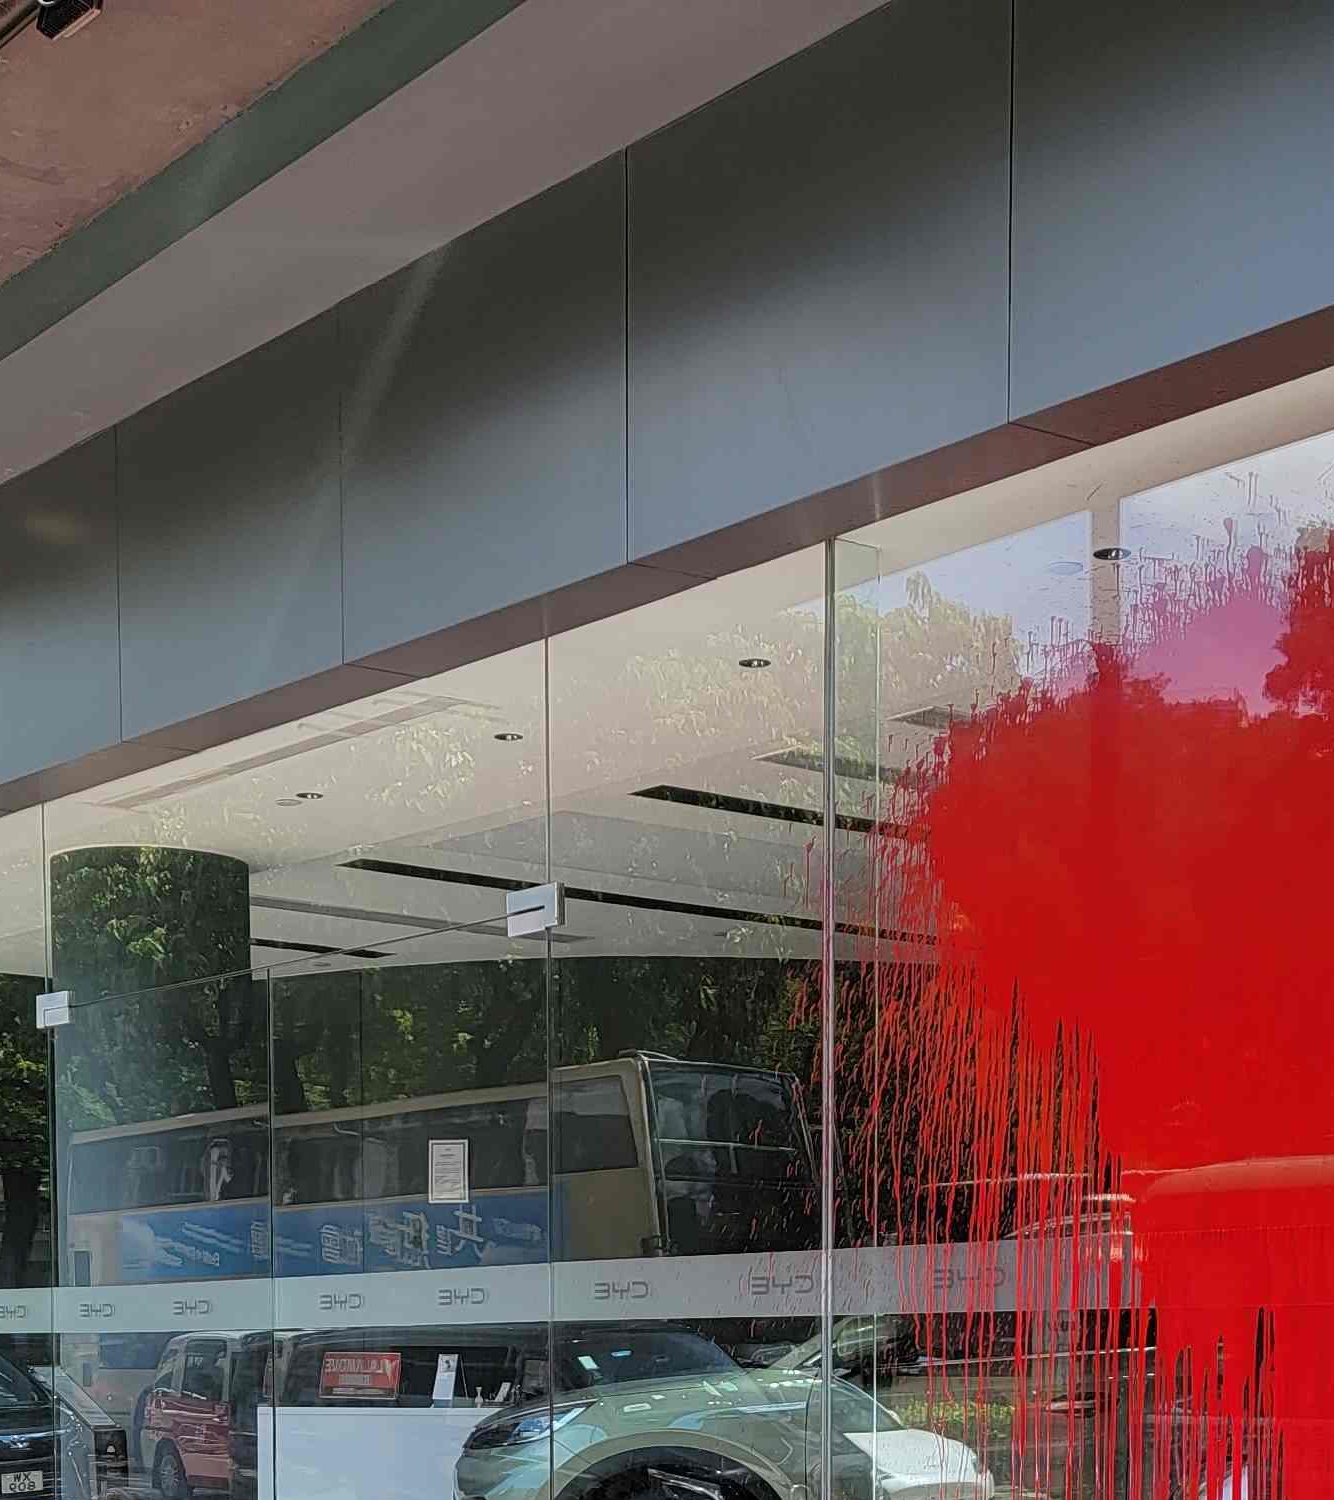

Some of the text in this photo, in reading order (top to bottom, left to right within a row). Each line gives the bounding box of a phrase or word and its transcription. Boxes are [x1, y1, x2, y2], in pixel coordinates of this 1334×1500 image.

[594, 1281, 650, 1300] BYD
[751, 1275, 814, 1296] BYD
[319, 1293, 364, 1311] BYD
[437, 1287, 487, 1306] BYD
[79, 1303, 114, 1318] BYD
[172, 1301, 212, 1316] BYD
